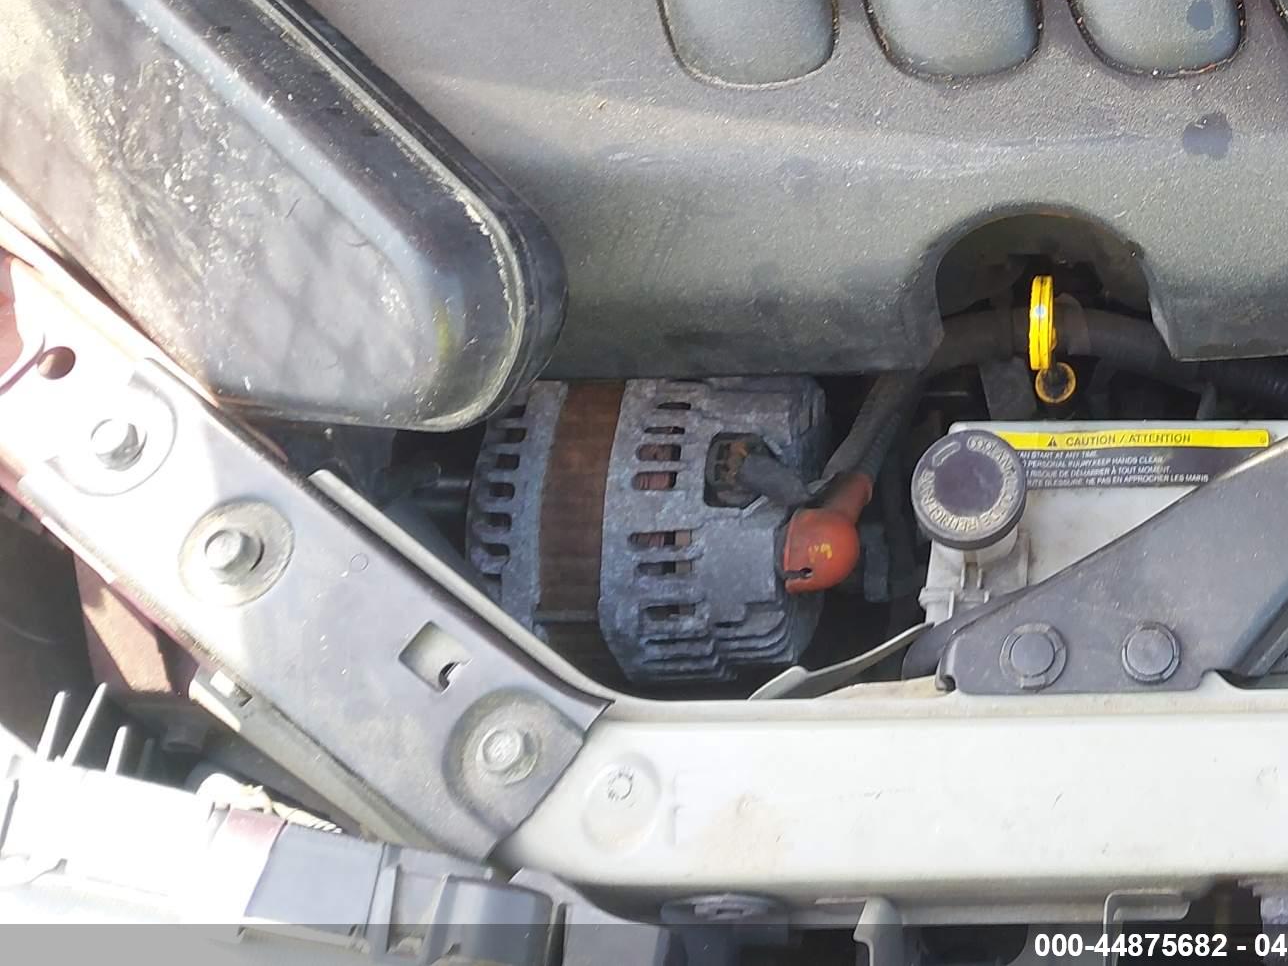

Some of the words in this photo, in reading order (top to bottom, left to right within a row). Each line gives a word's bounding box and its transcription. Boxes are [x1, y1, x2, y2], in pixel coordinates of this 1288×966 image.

[1065, 434, 1116, 447] CAUTION
[1127, 433, 1191, 445] ATTENTION
[1031, 451, 1053, 459] START
[1055, 451, 1064, 459] AT
[1065, 451, 1080, 459] ANY
[1028, 459, 1067, 468] PERSONAL
[1112, 457, 1138, 465] HANDS
[1058, 469, 1069, 477] DE
[1118, 466, 1136, 475] TOUT
[1085, 477, 1096, 485] NE
[1096, 476, 1112, 485] PAS
[1112, 475, 1123, 483] EN
[1123, 474, 1170, 483] APPROCHER
[1170, 474, 1185, 482] LES
[1185, 473, 1210, 482] MAINS
